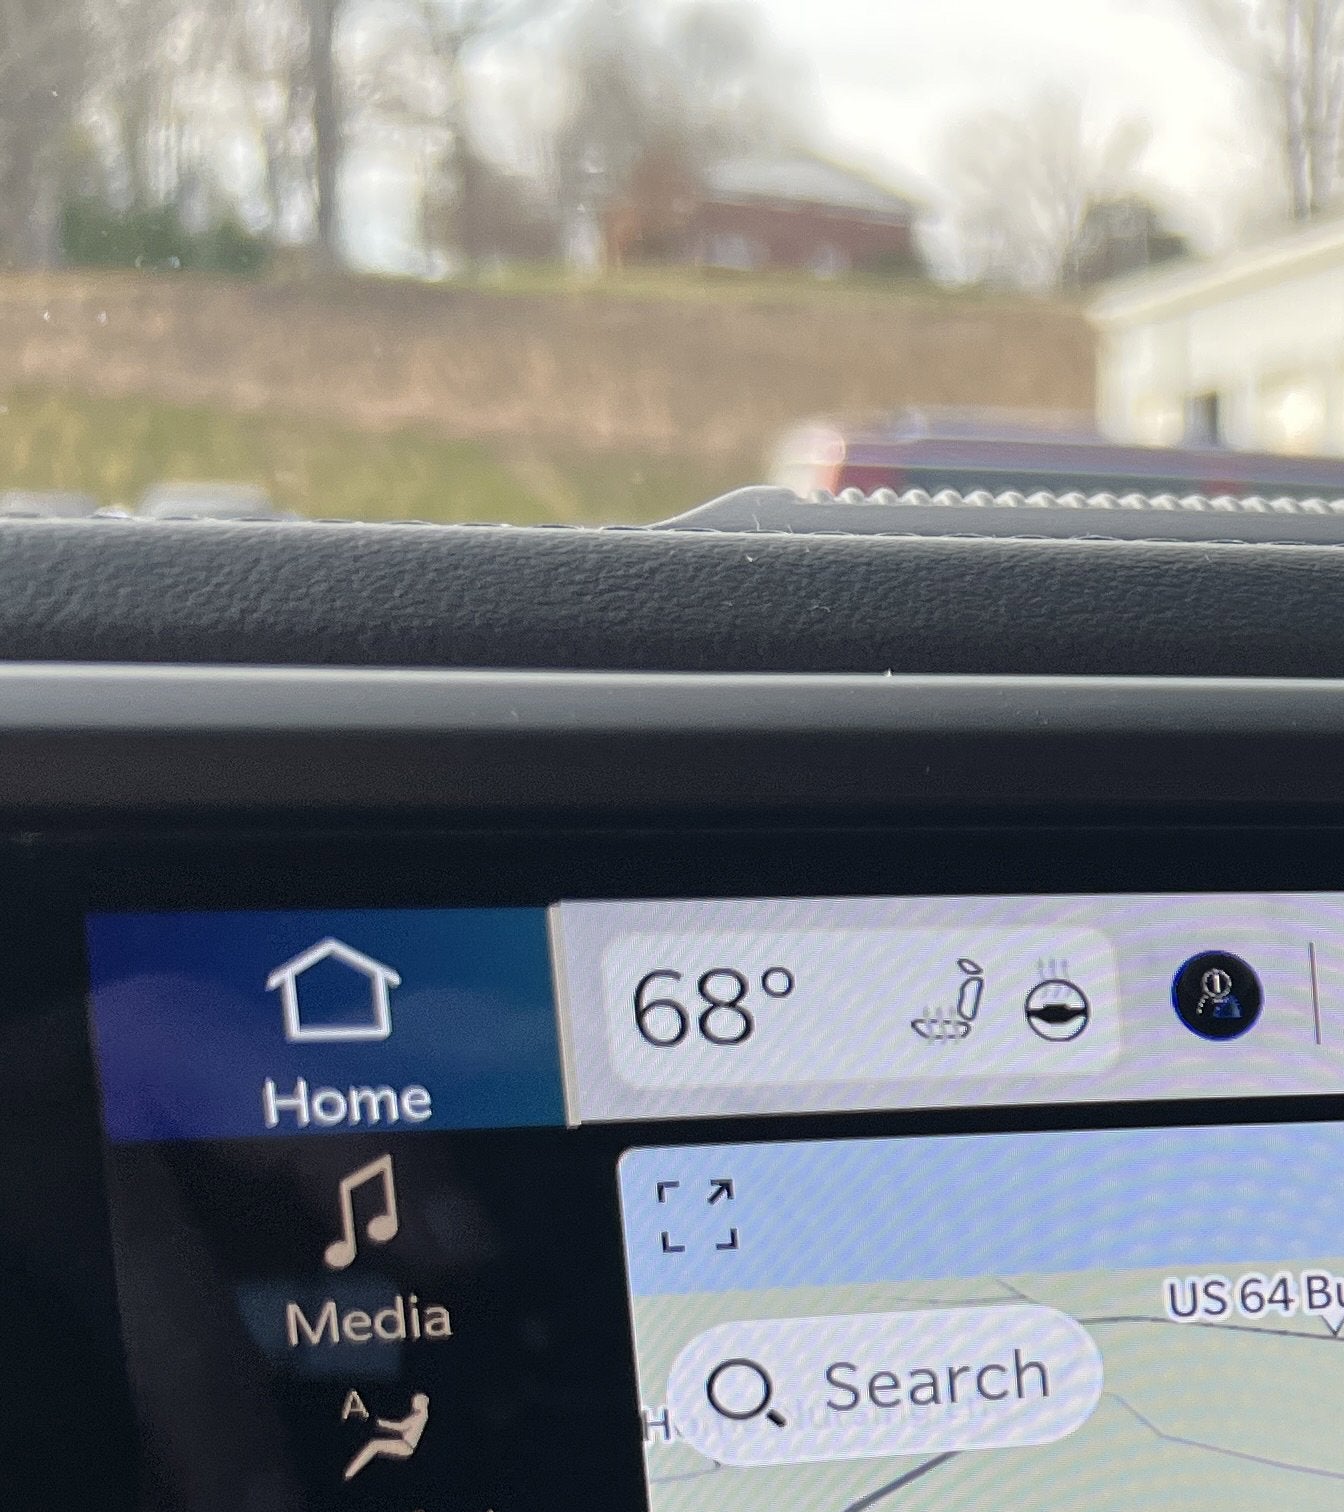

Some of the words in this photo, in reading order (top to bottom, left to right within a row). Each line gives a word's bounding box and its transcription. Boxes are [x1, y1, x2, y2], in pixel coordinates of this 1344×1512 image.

[633, 966, 796, 1047] 68°
[262, 1076, 433, 1128] Home
[285, 1293, 454, 1347] Media
[1168, 1280, 1230, 1318] US
[1239, 1277, 1295, 1314] 64
[824, 1348, 1050, 1412] Search
